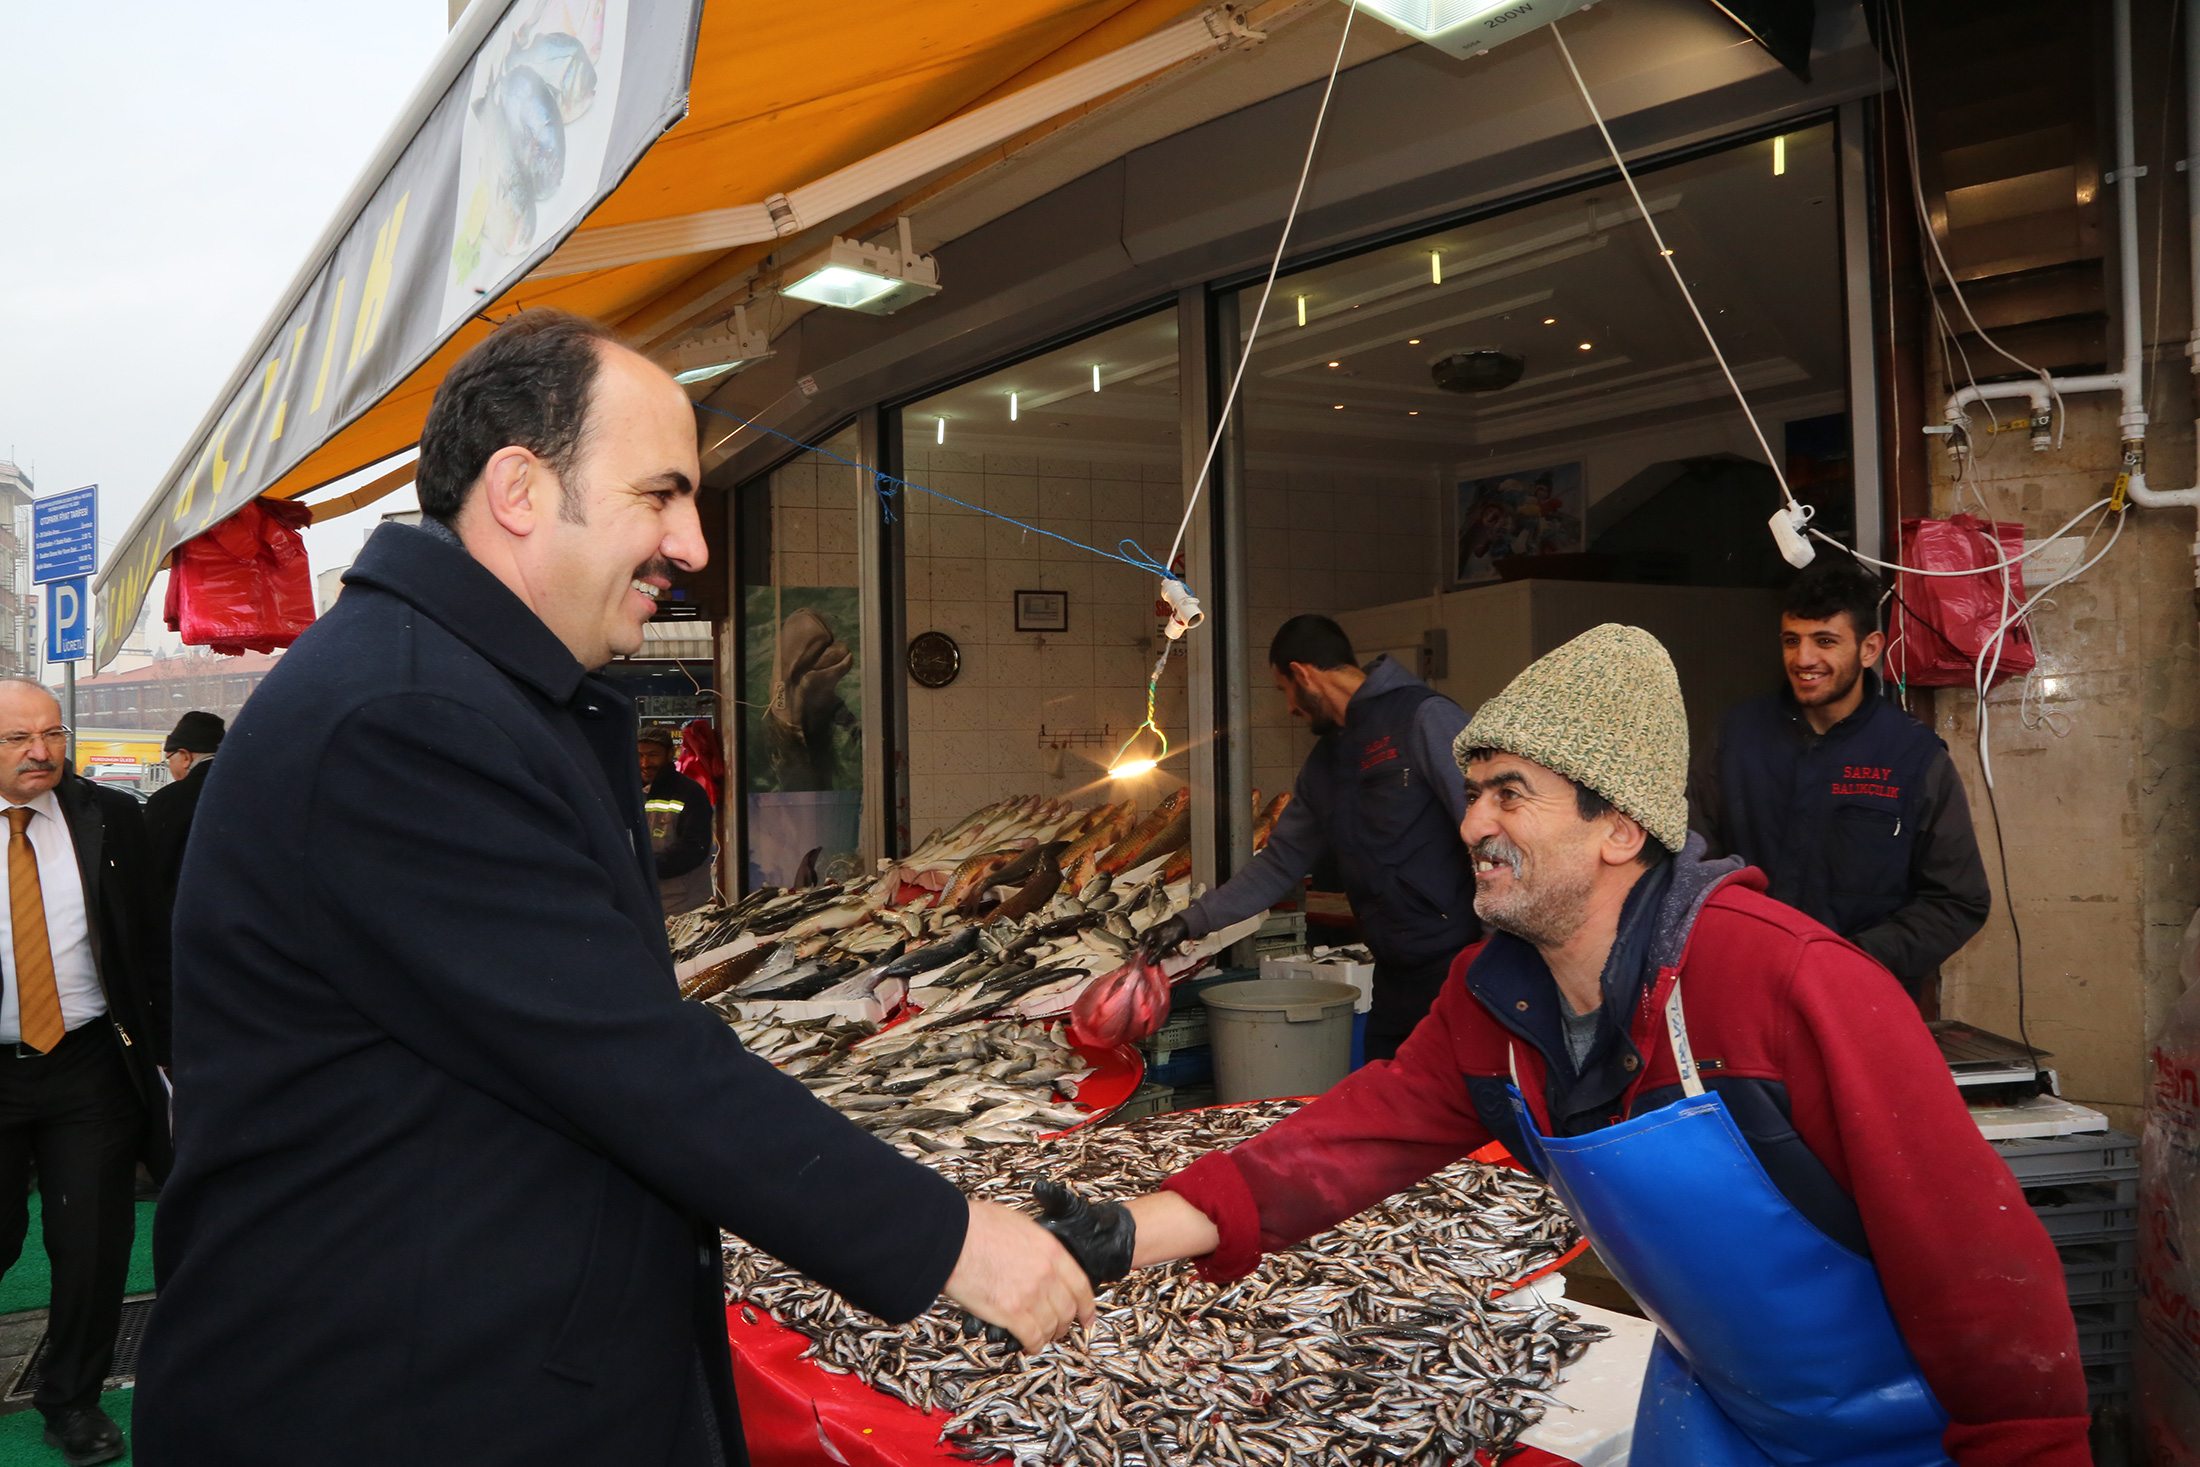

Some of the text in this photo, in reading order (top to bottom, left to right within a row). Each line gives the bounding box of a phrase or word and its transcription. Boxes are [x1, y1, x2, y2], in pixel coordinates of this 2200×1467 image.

[1484, 3, 1534, 29] 200W
[56, 585, 79, 653] P
[63, 635, 85, 652] ÜCRETLİ
[1843, 766, 1892, 780] SARAY
[1831, 783, 1900, 799] BALIKÇILIK
